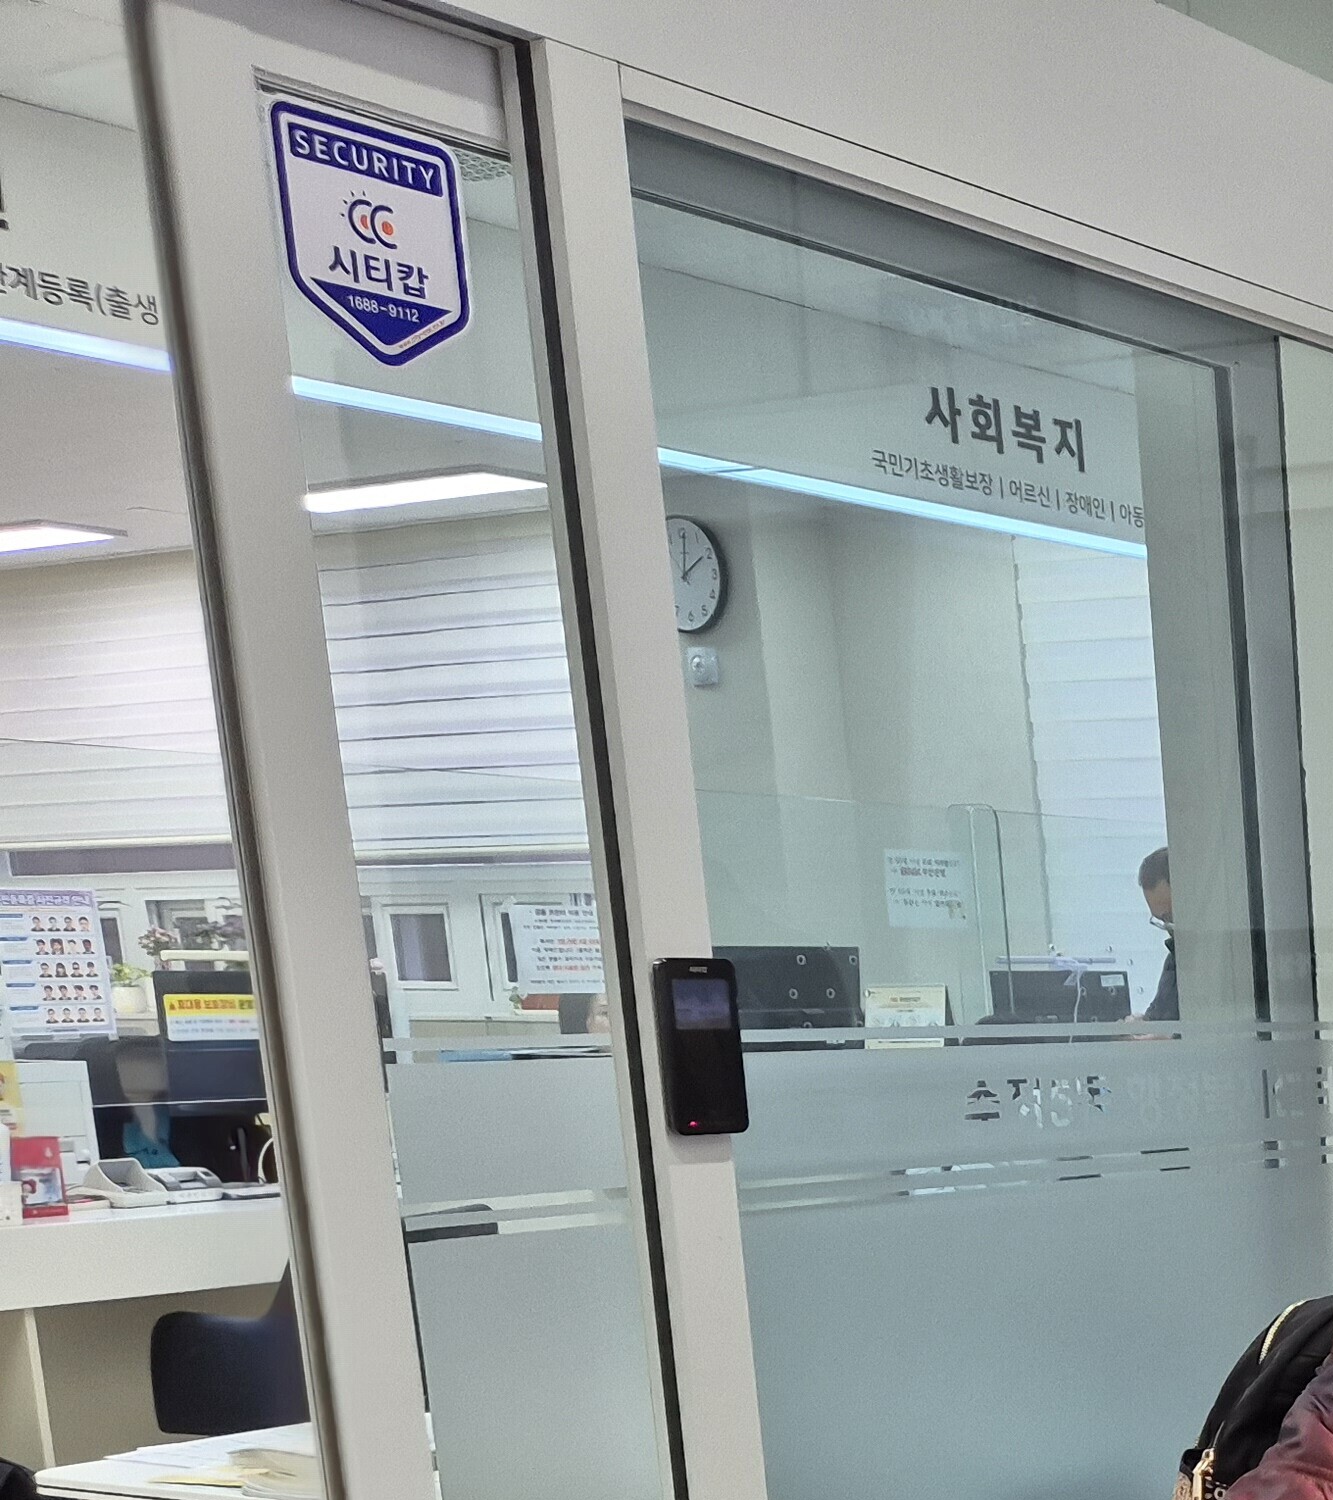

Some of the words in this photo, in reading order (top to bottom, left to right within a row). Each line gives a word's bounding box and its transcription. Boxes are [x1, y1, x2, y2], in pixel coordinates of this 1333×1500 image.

[294, 130, 436, 190] SECURITY
[329, 245, 430, 299] 시티캅
[347, 294, 421, 323] 1688-9112
[925, 386, 1087, 473] 사회복지
[871, 450, 994, 497] 국민기초생활보장
[1009, 480, 1051, 508] 어르신
[1065, 491, 1106, 520] 장애인
[1119, 505, 1146, 528] 아동
